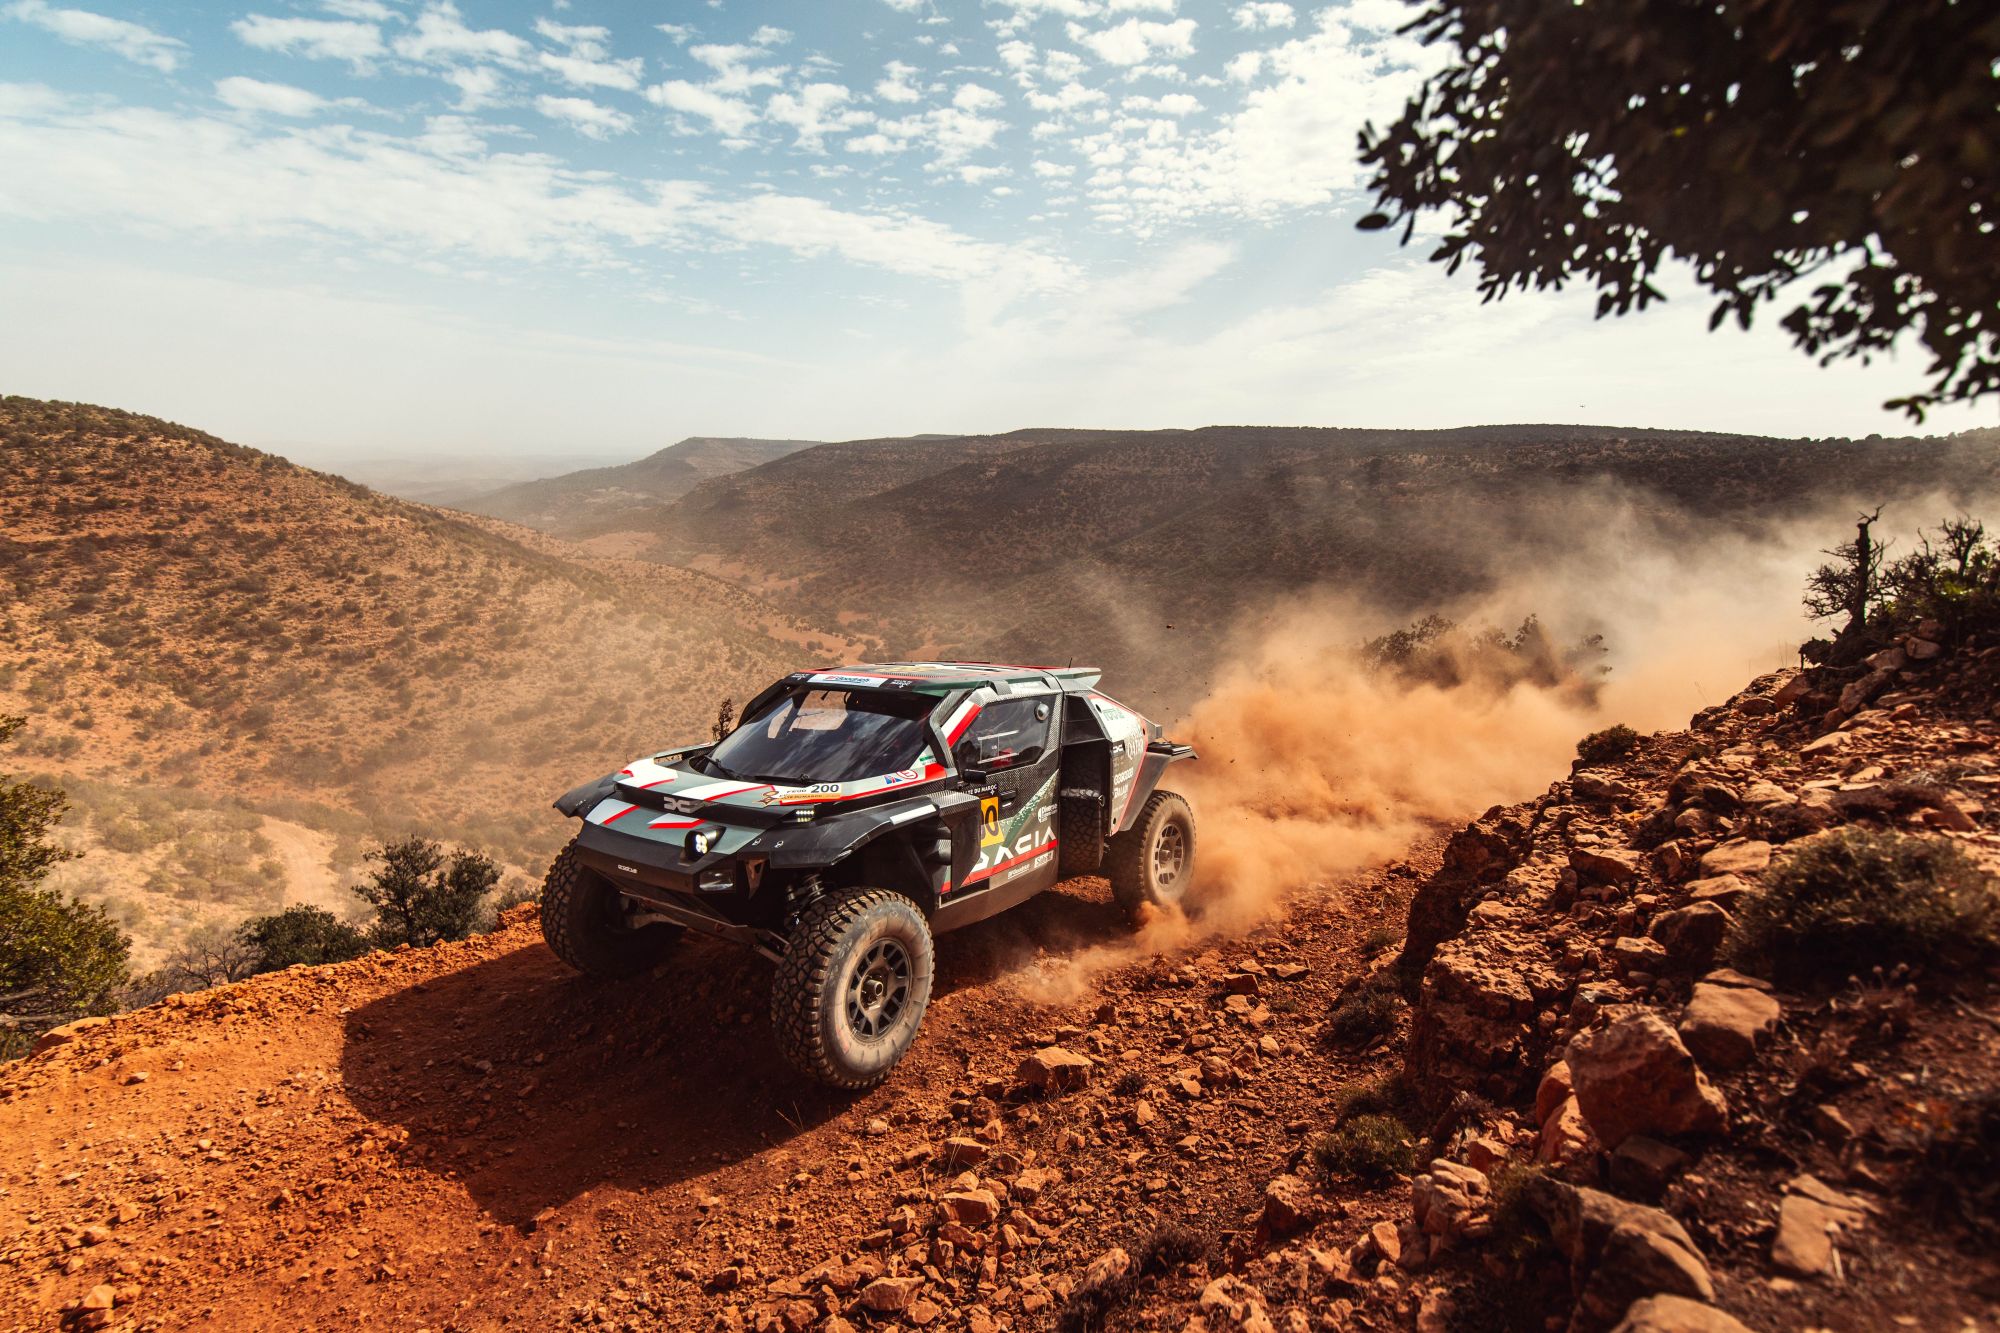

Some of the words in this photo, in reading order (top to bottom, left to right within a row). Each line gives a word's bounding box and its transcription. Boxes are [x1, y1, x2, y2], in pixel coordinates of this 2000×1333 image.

[810, 784, 840, 794] 200
[981, 784, 998, 793] MAROC
[970, 825, 1057, 873] DACIA
